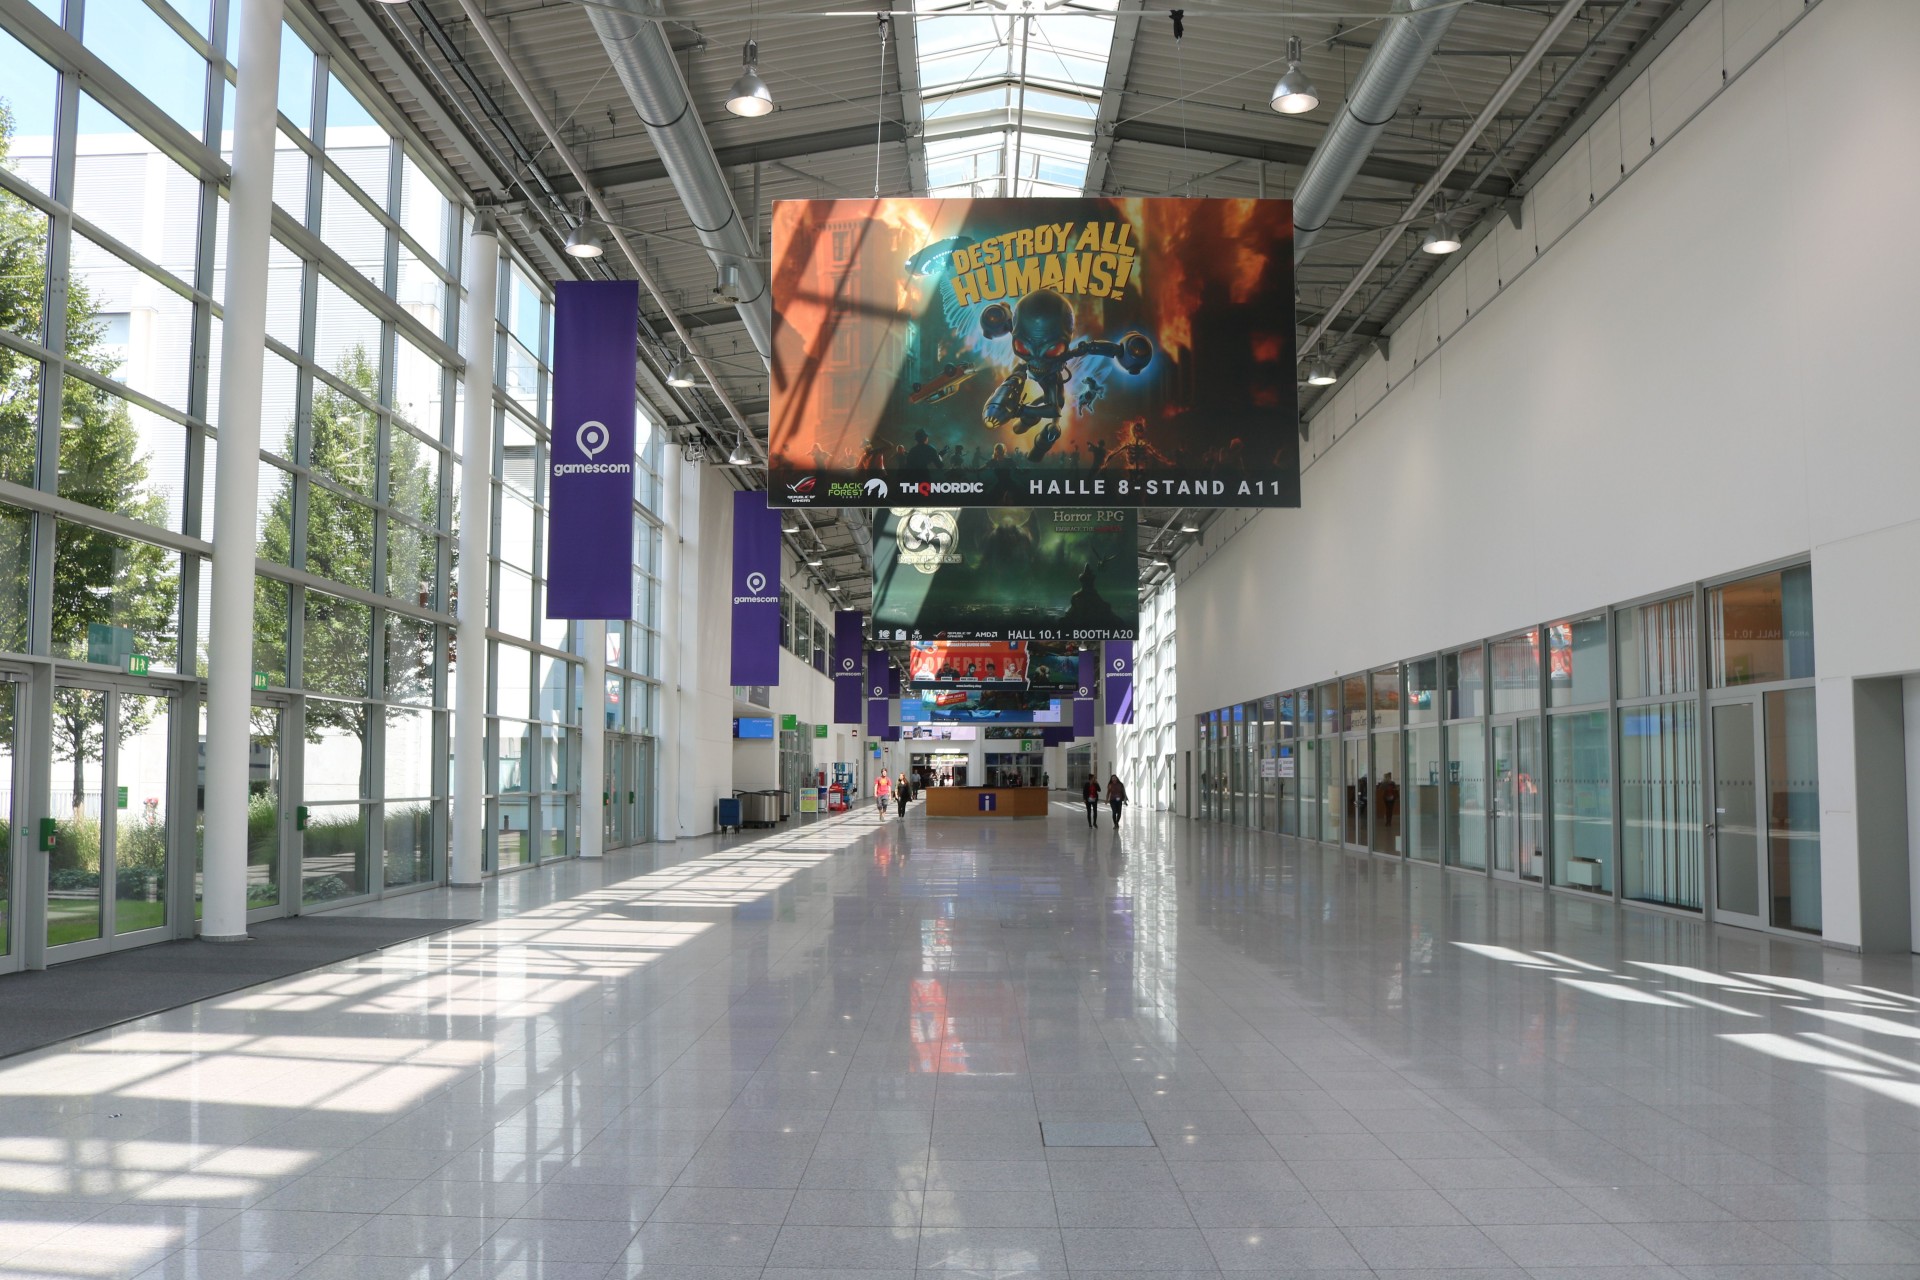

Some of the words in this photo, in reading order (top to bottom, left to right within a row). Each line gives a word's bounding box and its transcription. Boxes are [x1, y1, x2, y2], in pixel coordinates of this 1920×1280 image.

[952, 222, 1074, 275] DESTROY
[1075, 221, 1135, 257] ALL
[951, 253, 1134, 307] HUMANS!
[553, 463, 630, 477] gamescom
[1029, 479, 1106, 495] HALLE
[1237, 480, 1280, 495] A11
[1053, 511, 1092, 522] Horror
[1096, 510, 1125, 522] RPG
[733, 595, 778, 604] gamescom
[1008, 630, 1035, 639] HALL
[1039, 630, 1061, 639] 10.1
[1073, 630, 1110, 639] BOOTH
[1112, 630, 1134, 639] A20
[1025, 742, 1031, 751] 8
